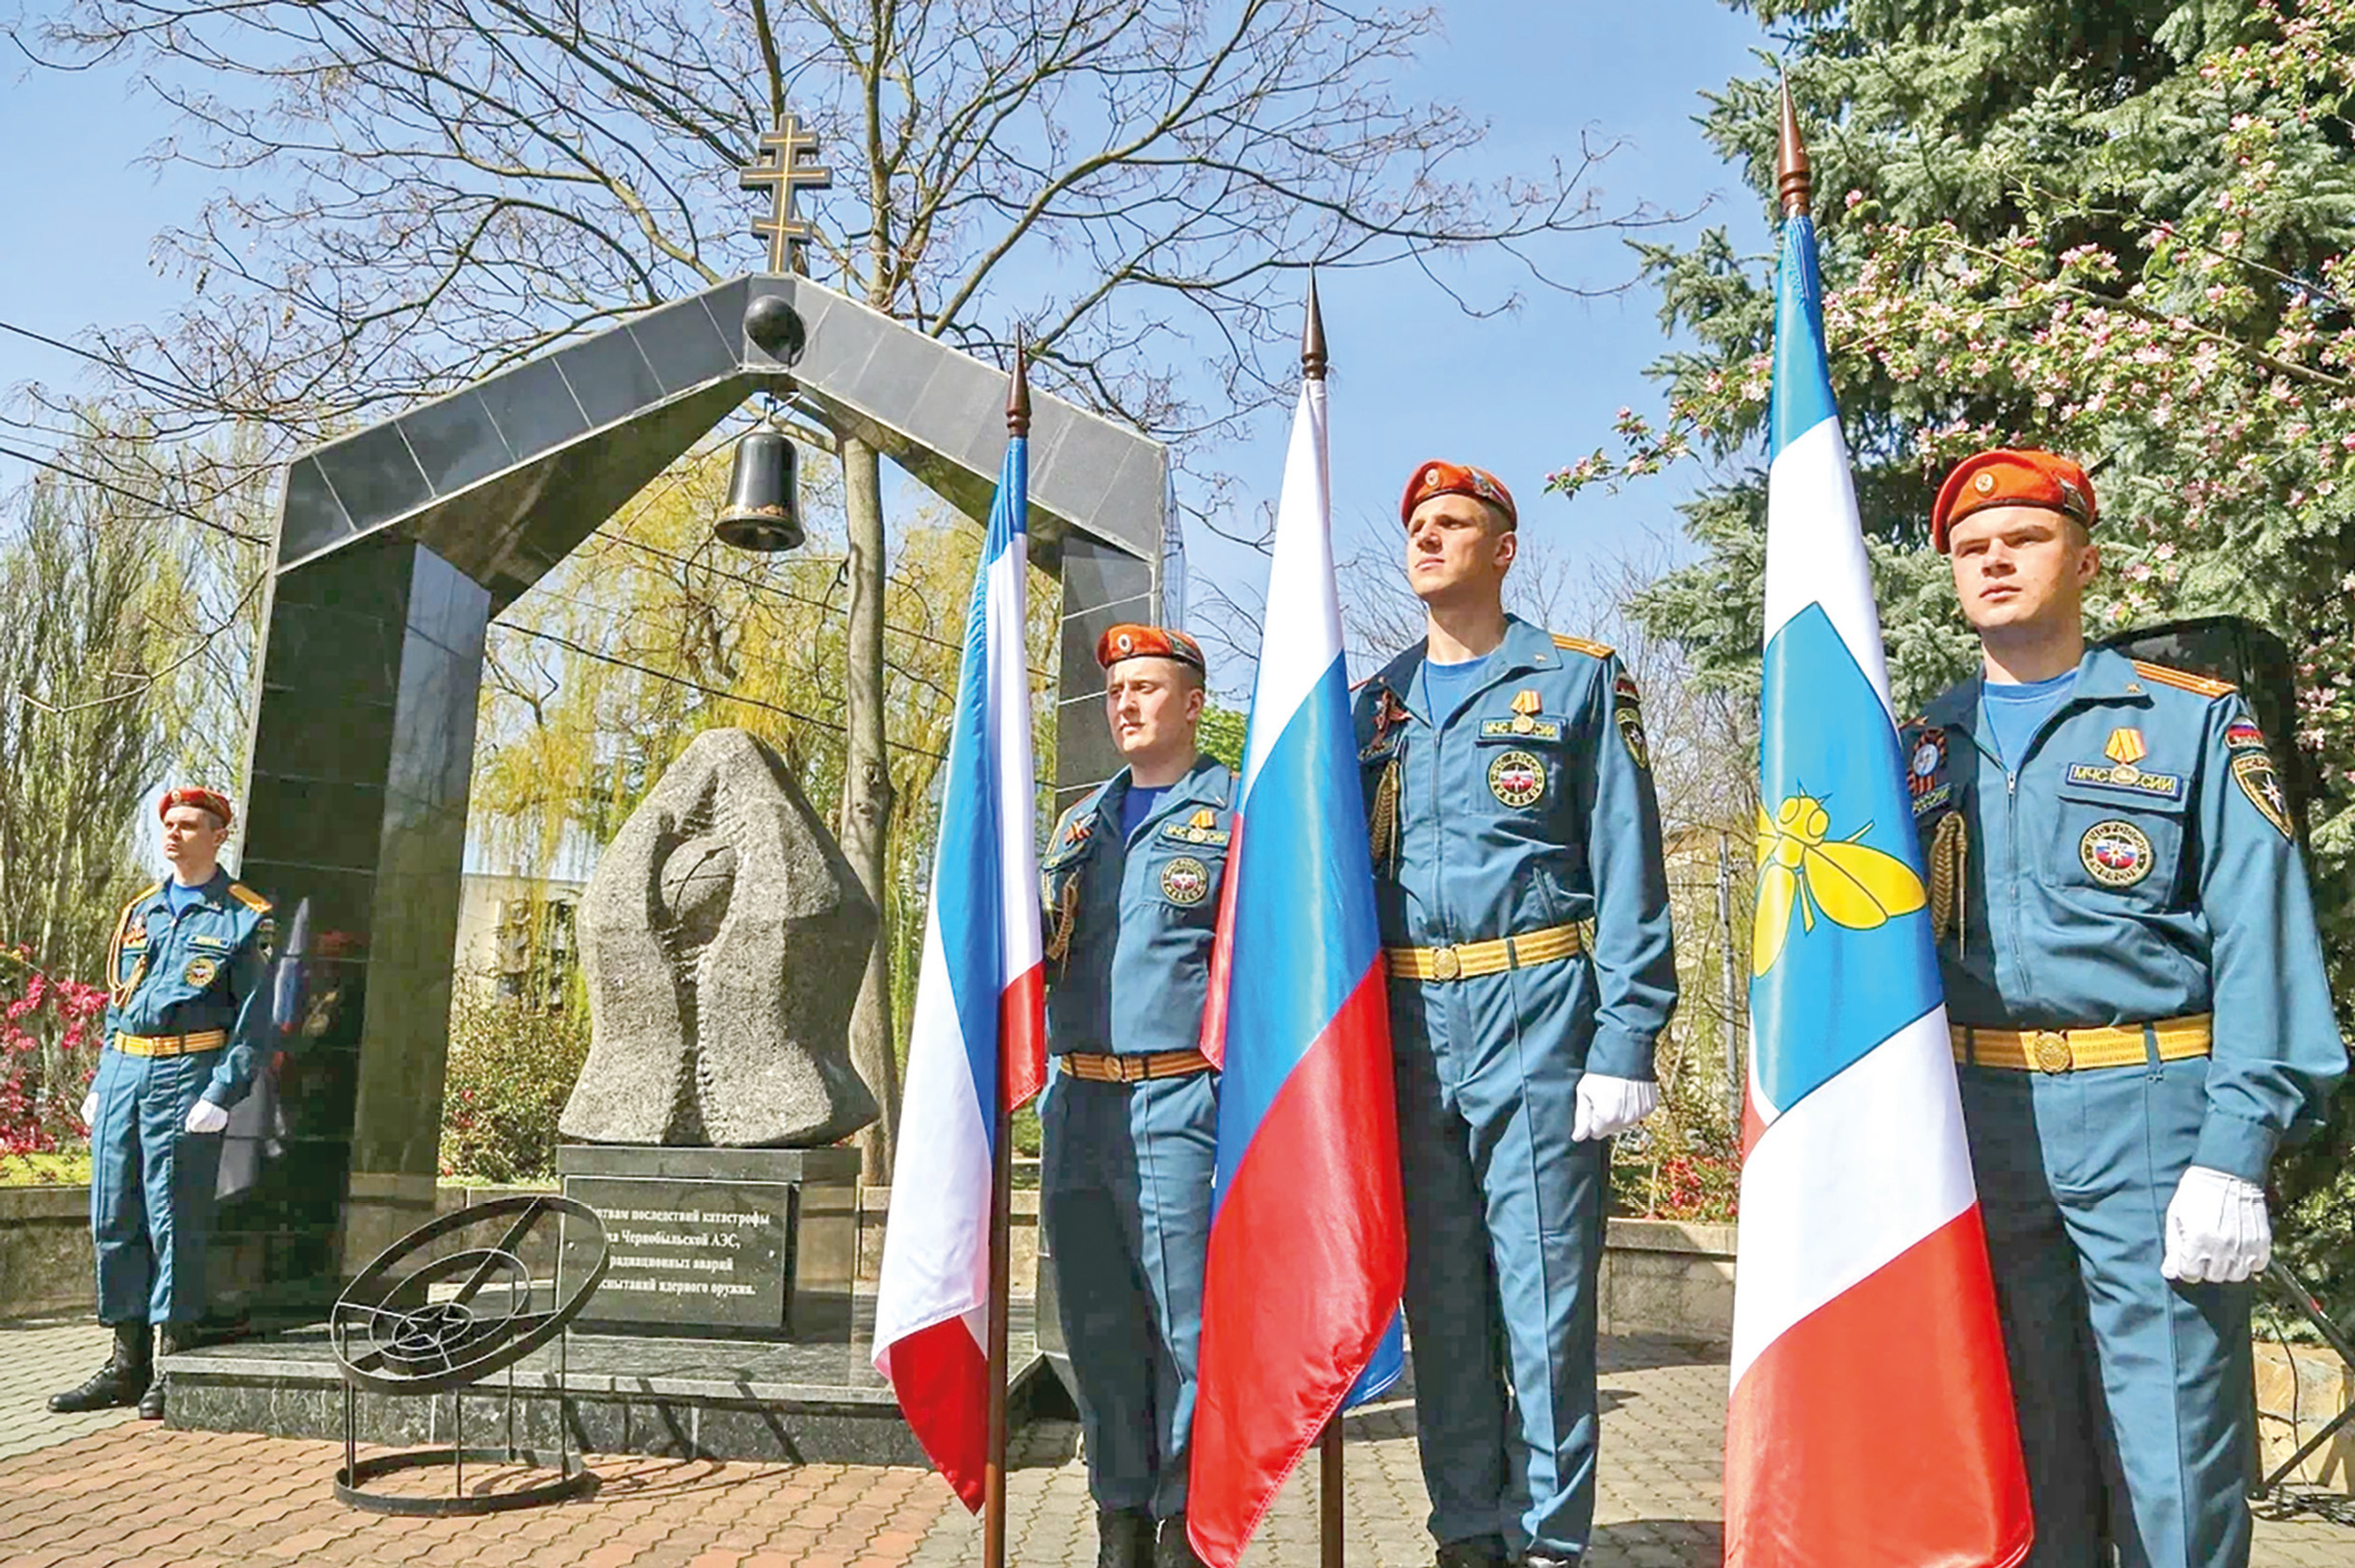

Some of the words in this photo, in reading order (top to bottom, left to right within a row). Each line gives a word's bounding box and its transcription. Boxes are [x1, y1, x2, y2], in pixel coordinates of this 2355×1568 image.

[2073, 766, 2109, 782] МЧС
[631, 1208, 700, 1222] последствий
[702, 1210, 770, 1228] катастрофы
[621, 1229, 710, 1247] Чернобыльской
[711, 1232, 741, 1249] АЭС,
[609, 1255, 691, 1270] радиационных
[692, 1257, 734, 1274] аварий
[599, 1277, 657, 1291] спытаний
[659, 1281, 709, 1297] ядерного
[711, 1283, 757, 1298] оружия.
